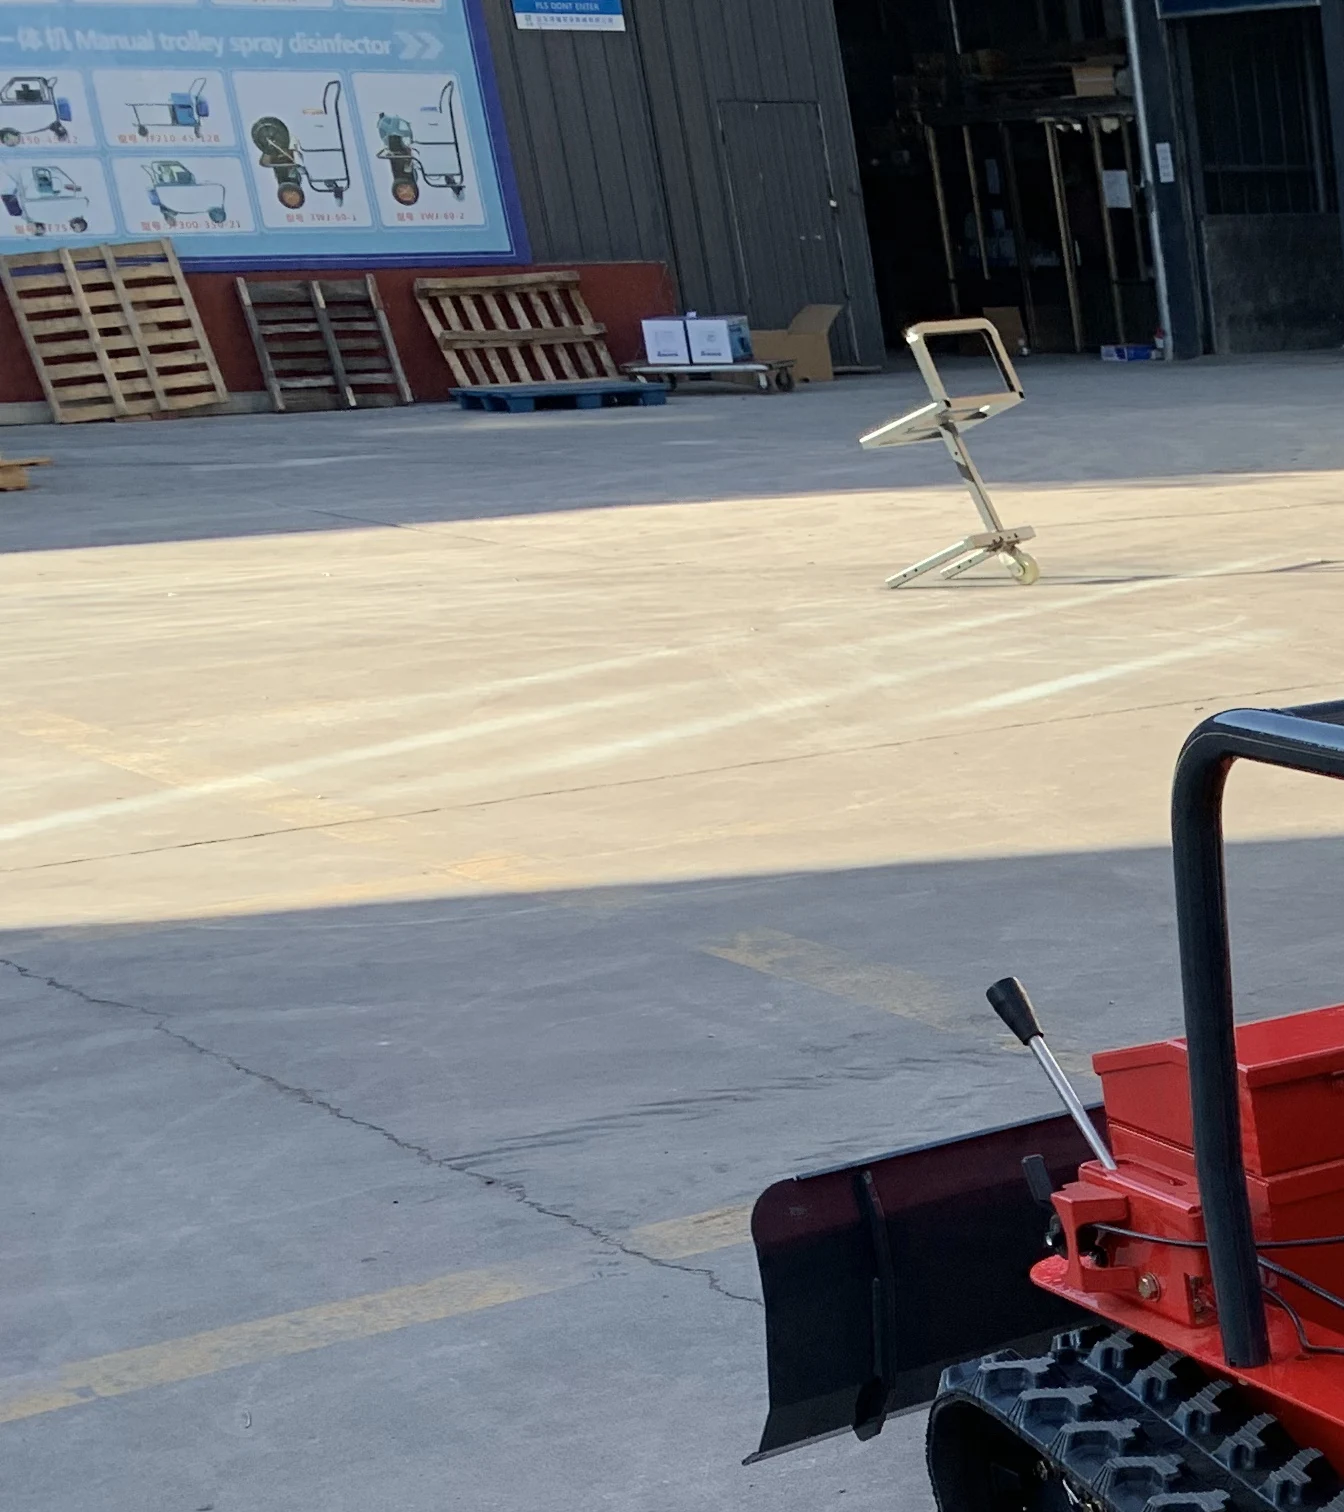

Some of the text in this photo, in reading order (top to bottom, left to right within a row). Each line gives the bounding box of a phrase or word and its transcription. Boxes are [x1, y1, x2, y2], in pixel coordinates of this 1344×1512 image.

[74, 29, 155, 50] Manual
[159, 29, 224, 58] trolley
[230, 35, 284, 59] spray
[289, 31, 391, 55] disinfector
